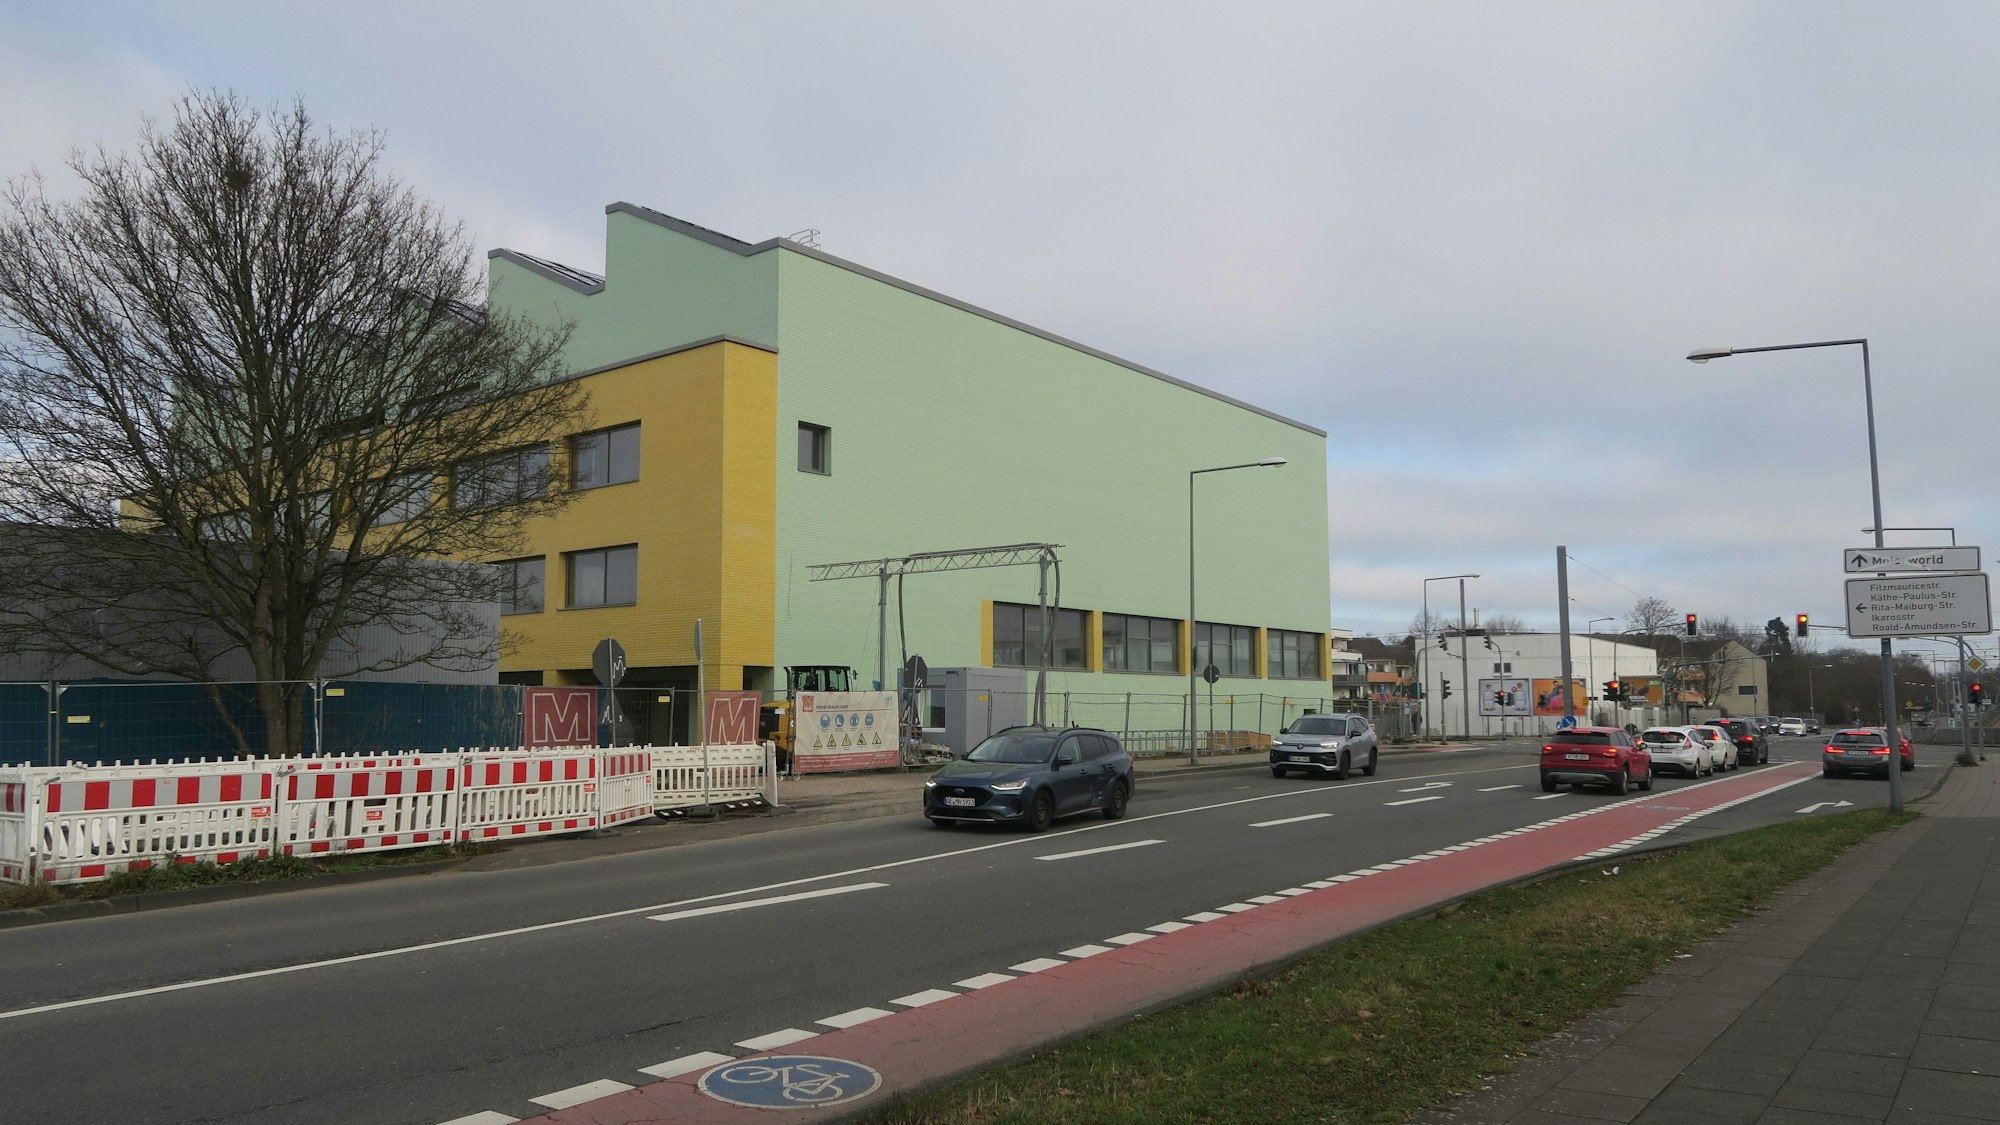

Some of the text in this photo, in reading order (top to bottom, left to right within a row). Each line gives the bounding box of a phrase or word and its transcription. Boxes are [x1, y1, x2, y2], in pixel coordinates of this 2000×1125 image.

[1870, 582, 1941, 592] Fitzmauricestr.
[1871, 601, 1956, 612] Rita-Maiburg-Str.
[1872, 620, 1979, 632] Roald-Amundsen-Str.
[532, 692, 591, 744] M
[709, 697, 757, 745] M
